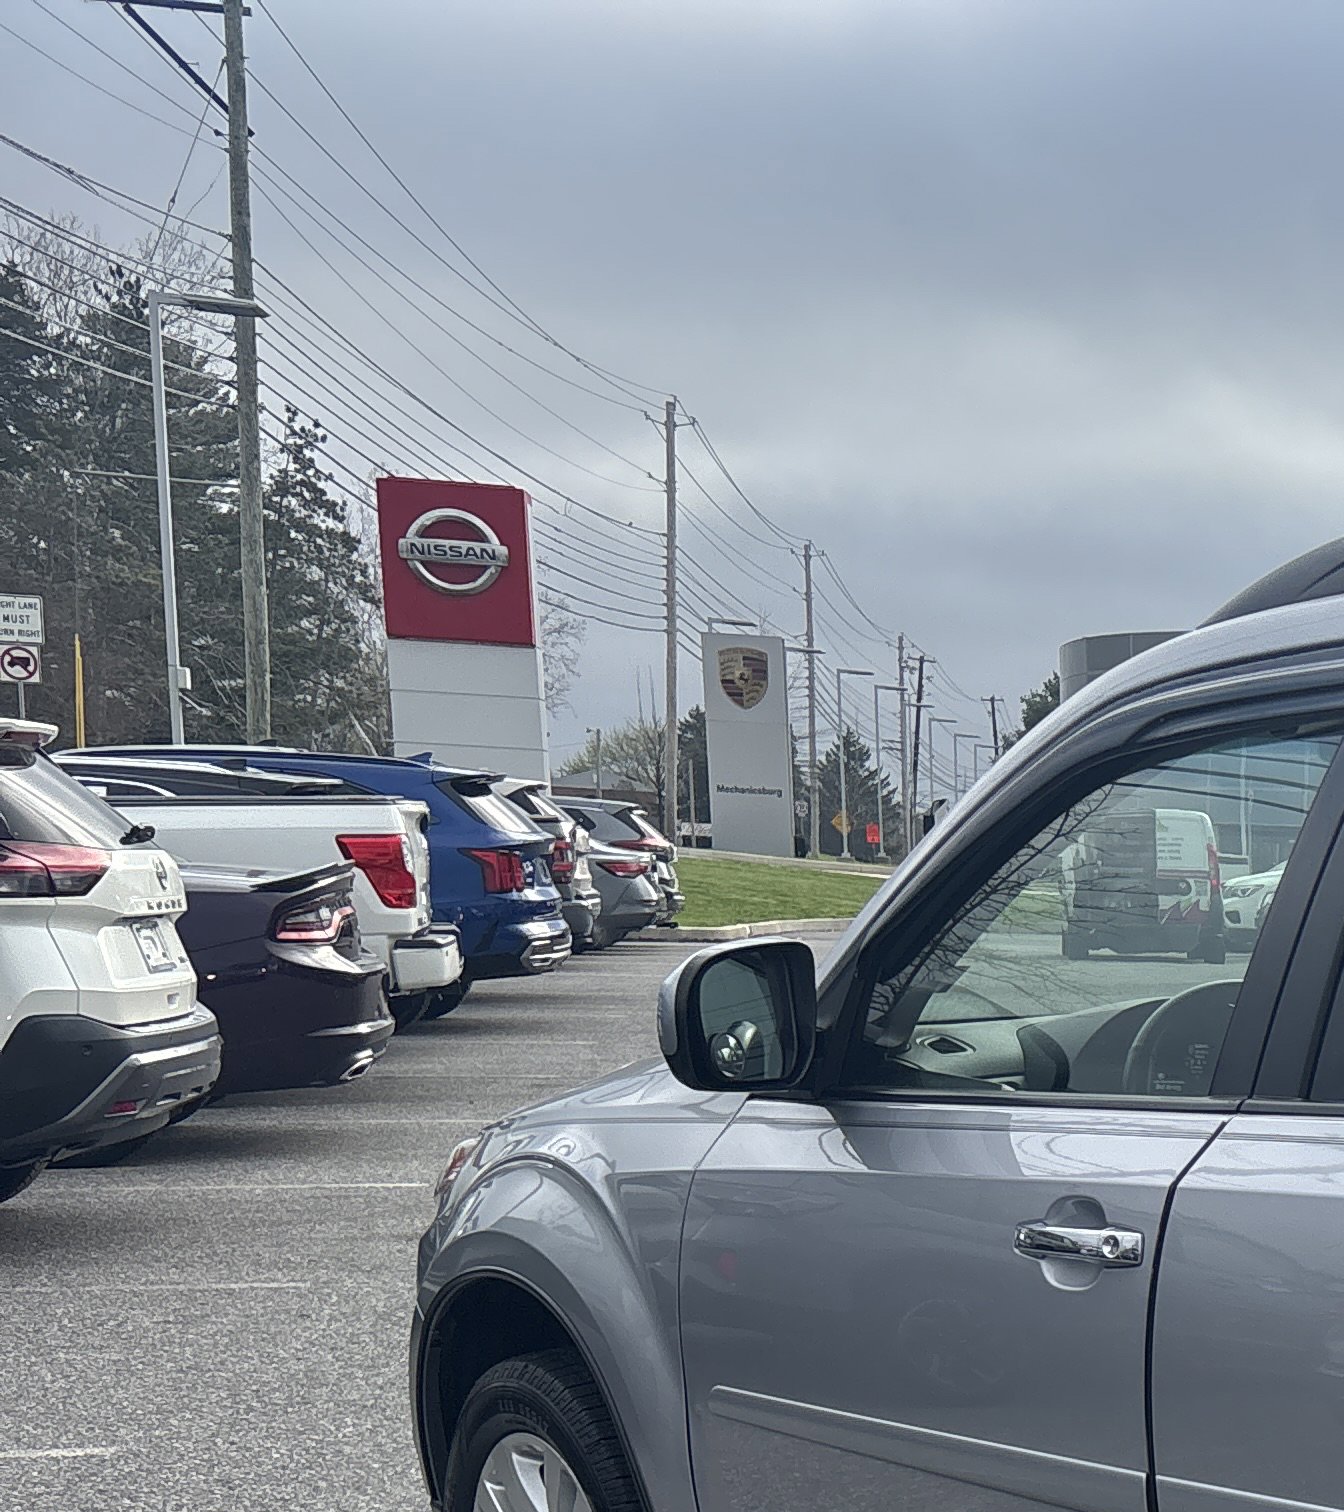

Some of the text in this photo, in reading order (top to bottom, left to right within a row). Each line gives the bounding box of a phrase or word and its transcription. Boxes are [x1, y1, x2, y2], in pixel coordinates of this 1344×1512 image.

[409, 541, 497, 561] NISSAN
[18, 601, 39, 610] LANE
[2, 613, 31, 624] MUST
[18, 629, 41, 638] RIGHT
